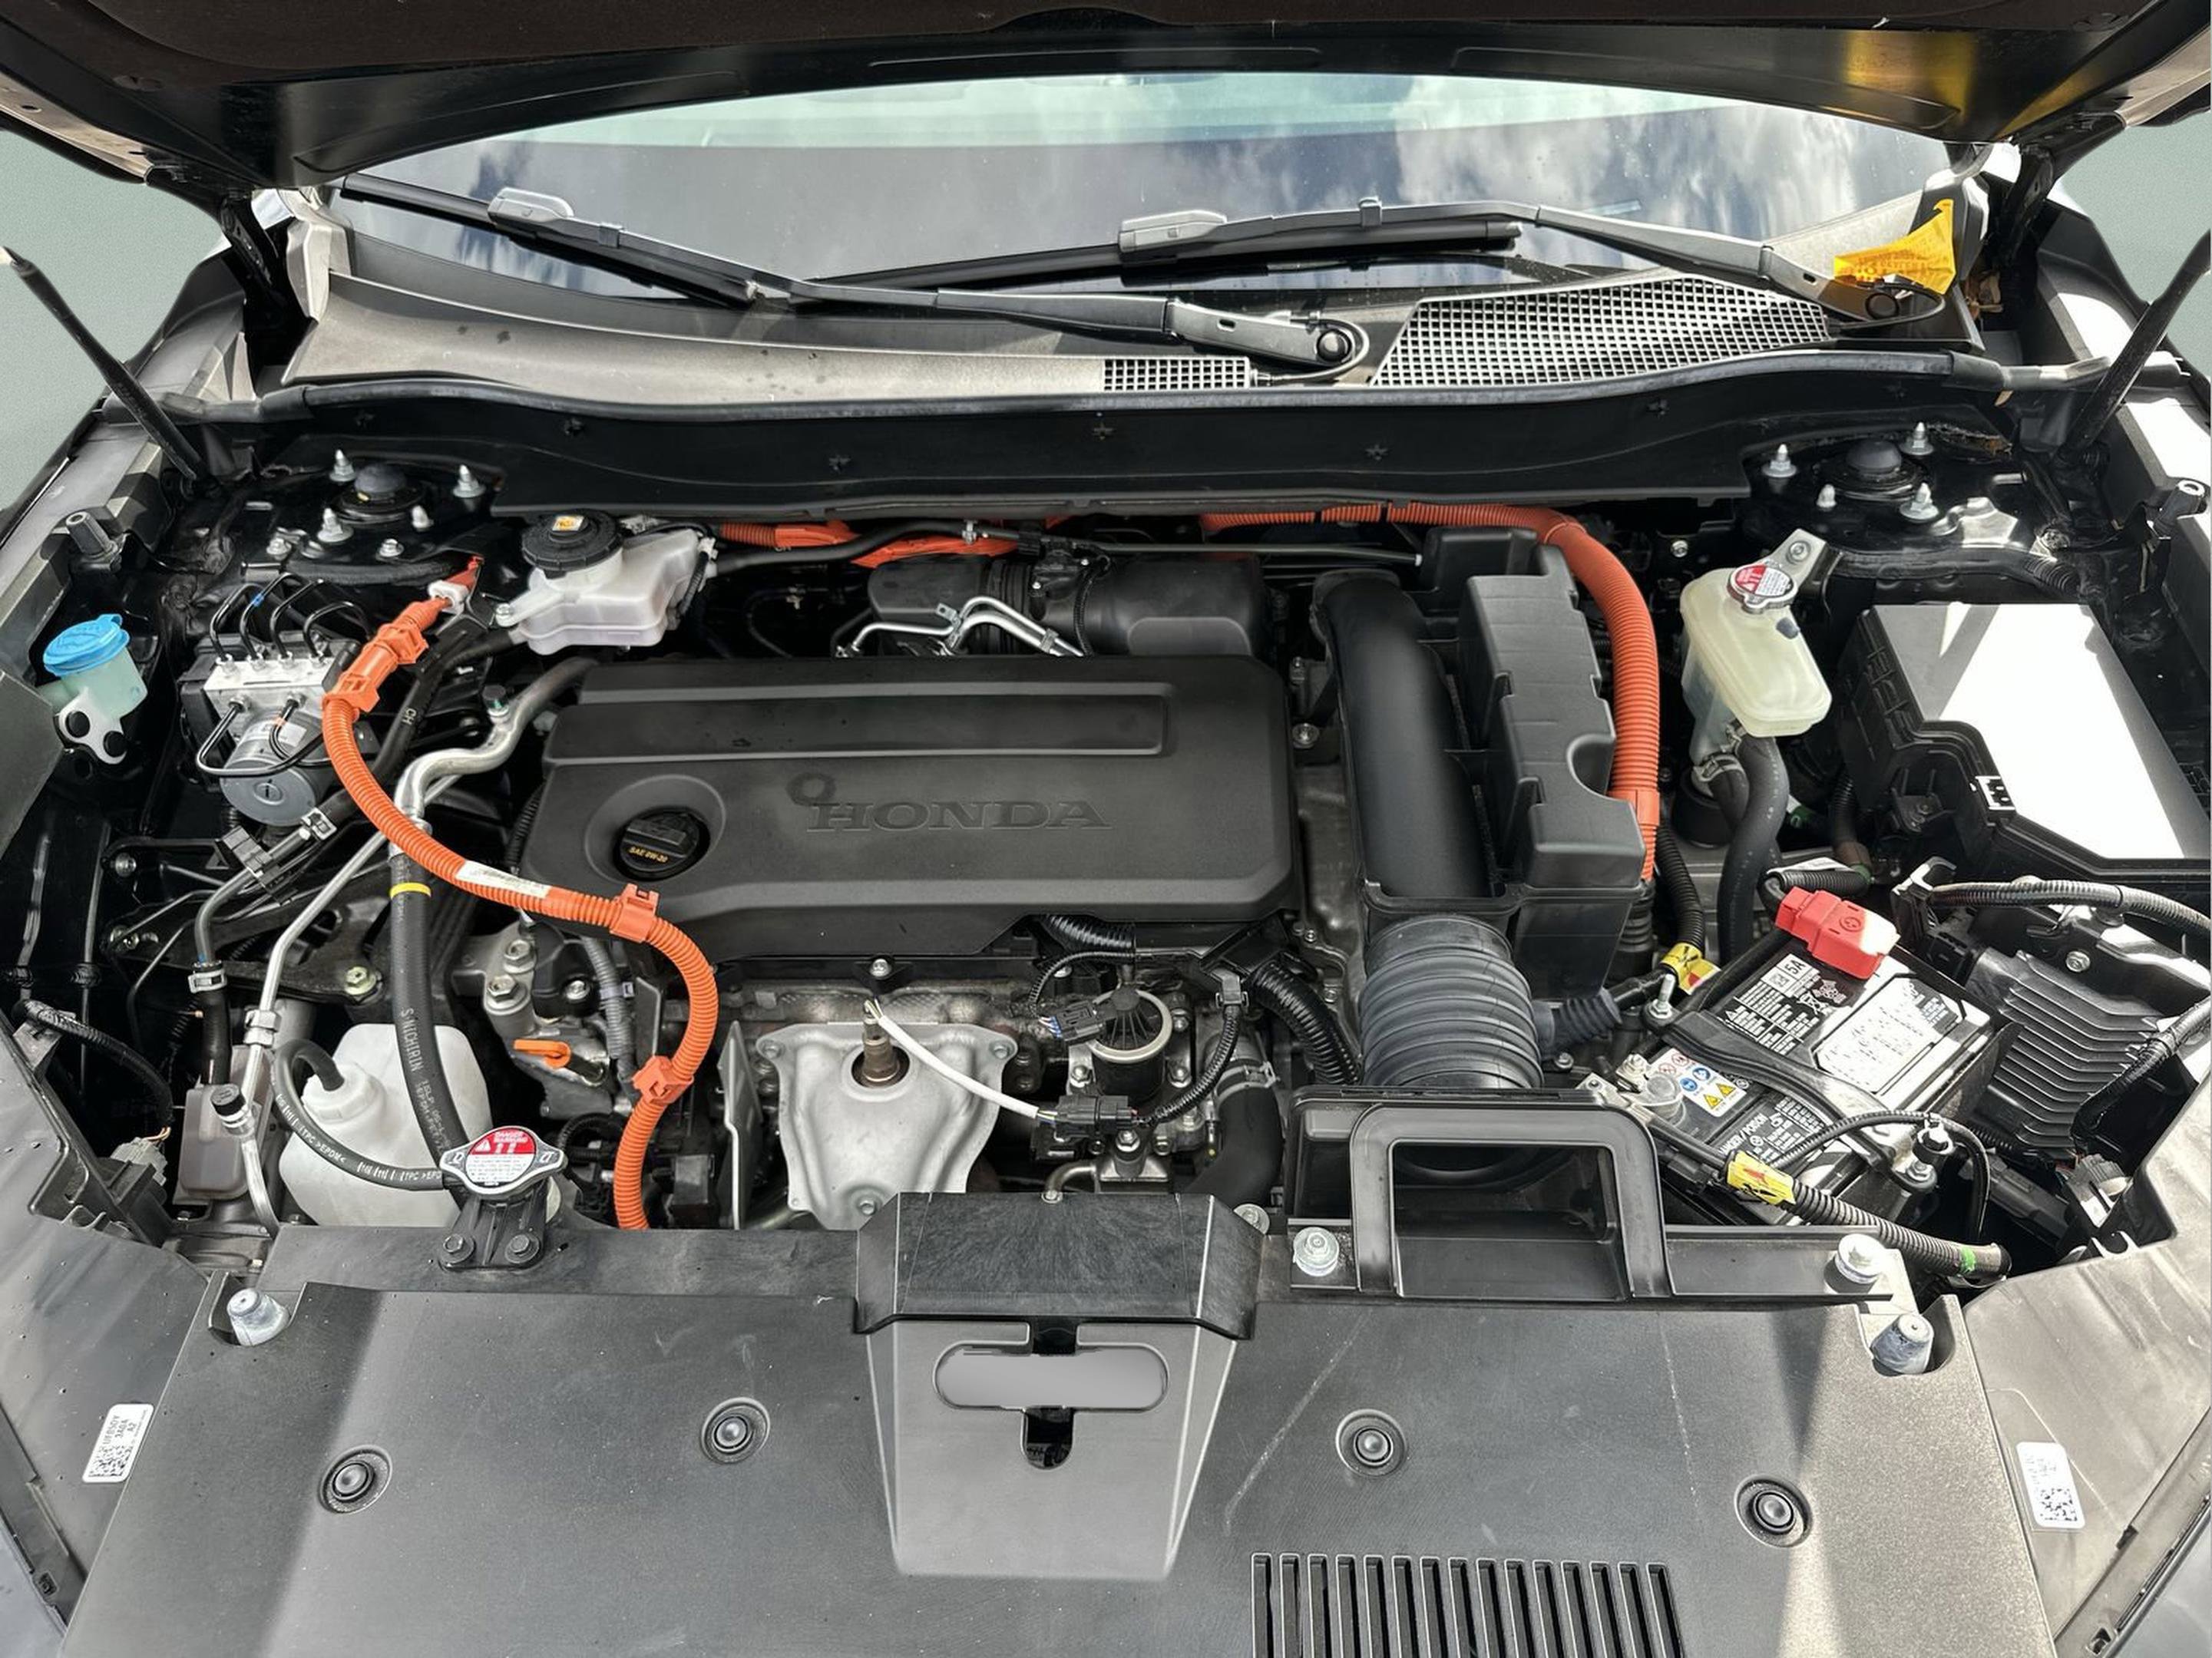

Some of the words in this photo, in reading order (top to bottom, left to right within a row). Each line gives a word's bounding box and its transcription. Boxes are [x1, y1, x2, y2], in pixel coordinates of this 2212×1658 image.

[806, 800, 1113, 832] HONDA
[629, 846, 646, 857] SAE
[1784, 959, 1805, 975] 5A
